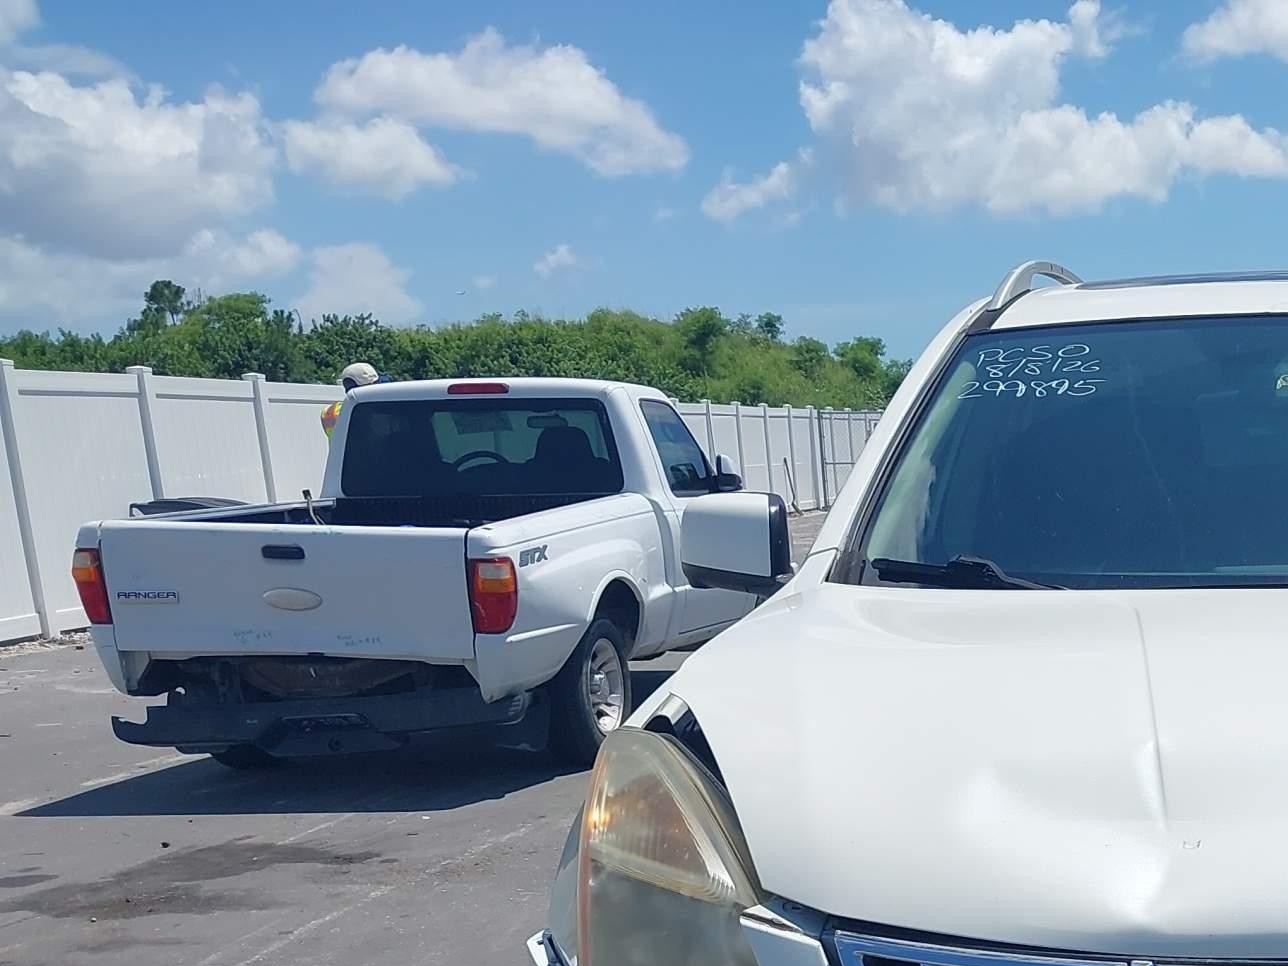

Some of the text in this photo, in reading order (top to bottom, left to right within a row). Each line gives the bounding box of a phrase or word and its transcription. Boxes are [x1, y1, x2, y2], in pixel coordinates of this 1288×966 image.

[977, 344, 1090, 368] PCSO
[519, 544, 549, 567] STX
[117, 591, 177, 599] RANGER
